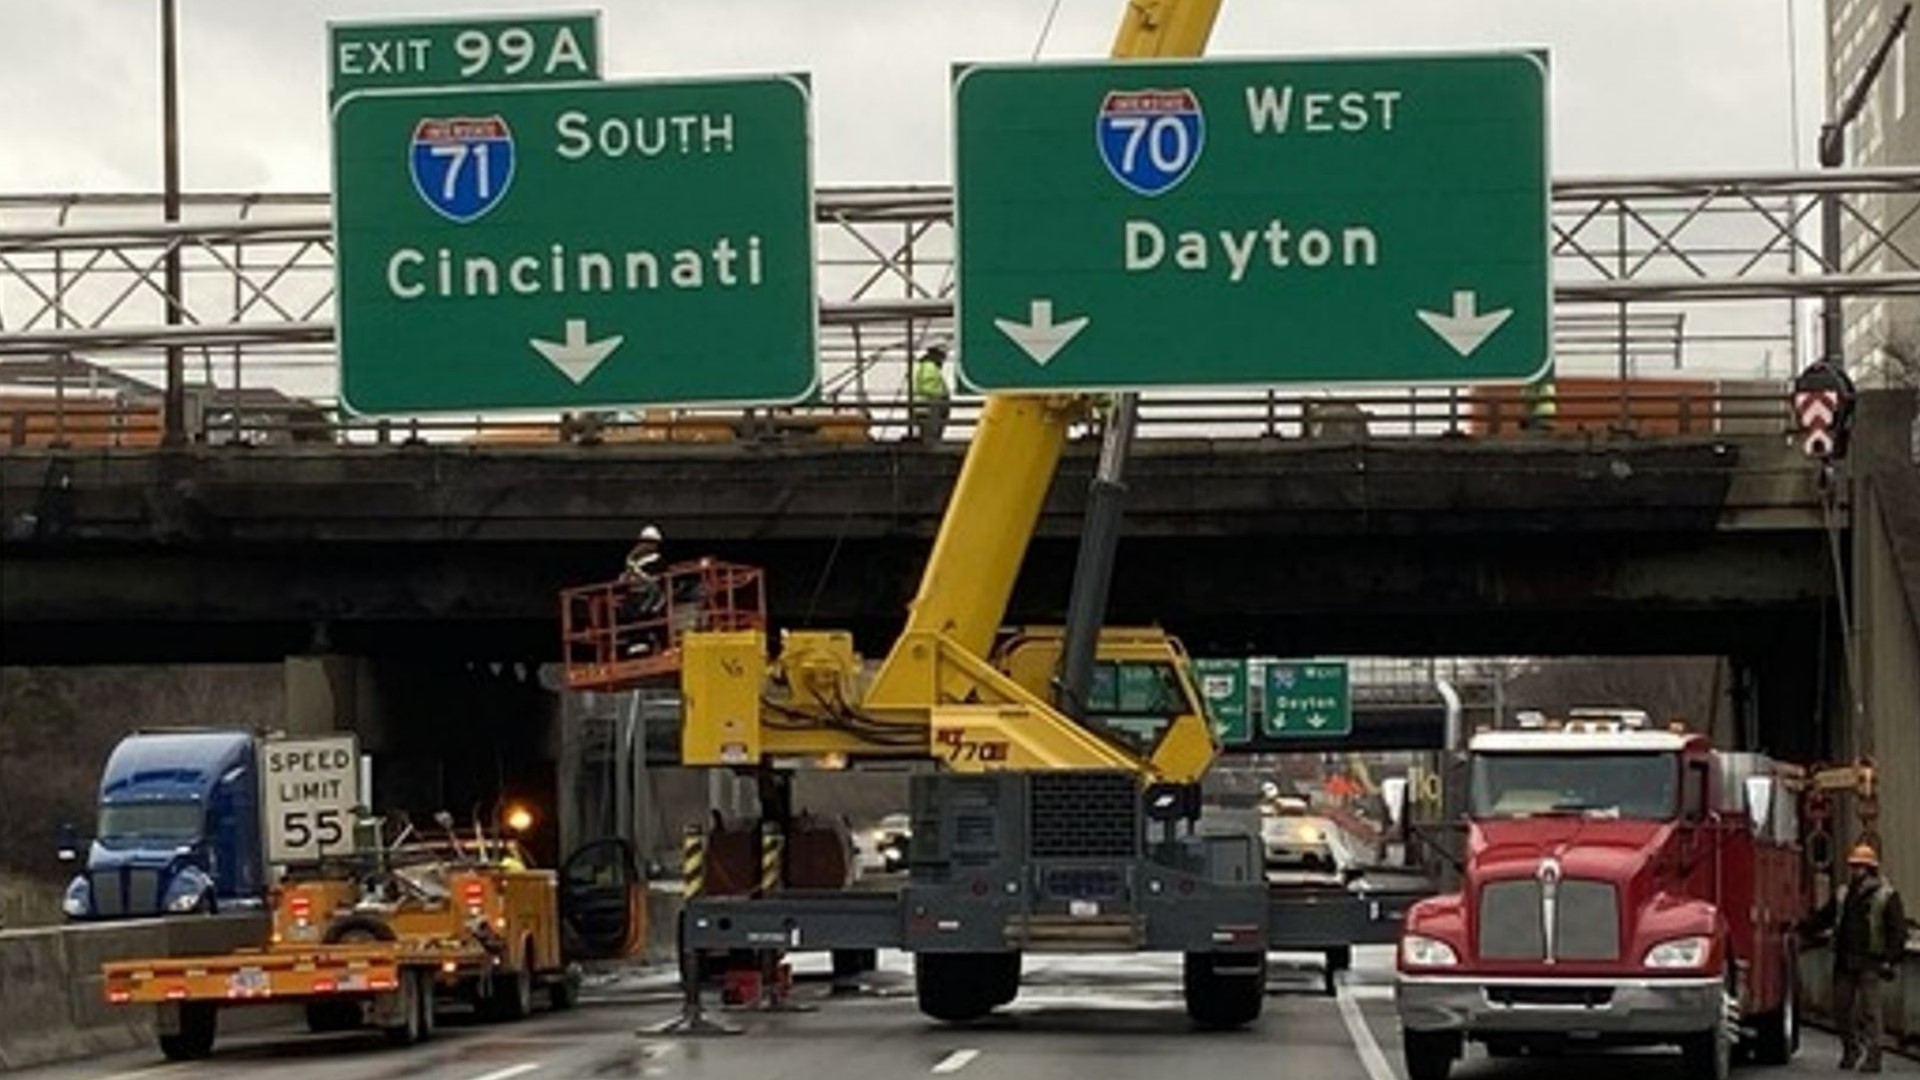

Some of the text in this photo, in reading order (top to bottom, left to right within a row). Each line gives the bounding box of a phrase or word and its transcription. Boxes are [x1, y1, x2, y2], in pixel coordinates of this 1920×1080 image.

[340, 27, 588, 76] EXIT 99A
[1245, 86, 1401, 134] WEST
[556, 112, 734, 158] SOUTH
[1111, 117, 1188, 173] 70
[431, 143, 488, 199] 71
[387, 236, 763, 298] Cincinnati
[1124, 220, 1379, 280] Dayton
[269, 748, 350, 773] SPEED
[280, 779, 342, 802] LIMIT
[284, 809, 343, 848] 55
